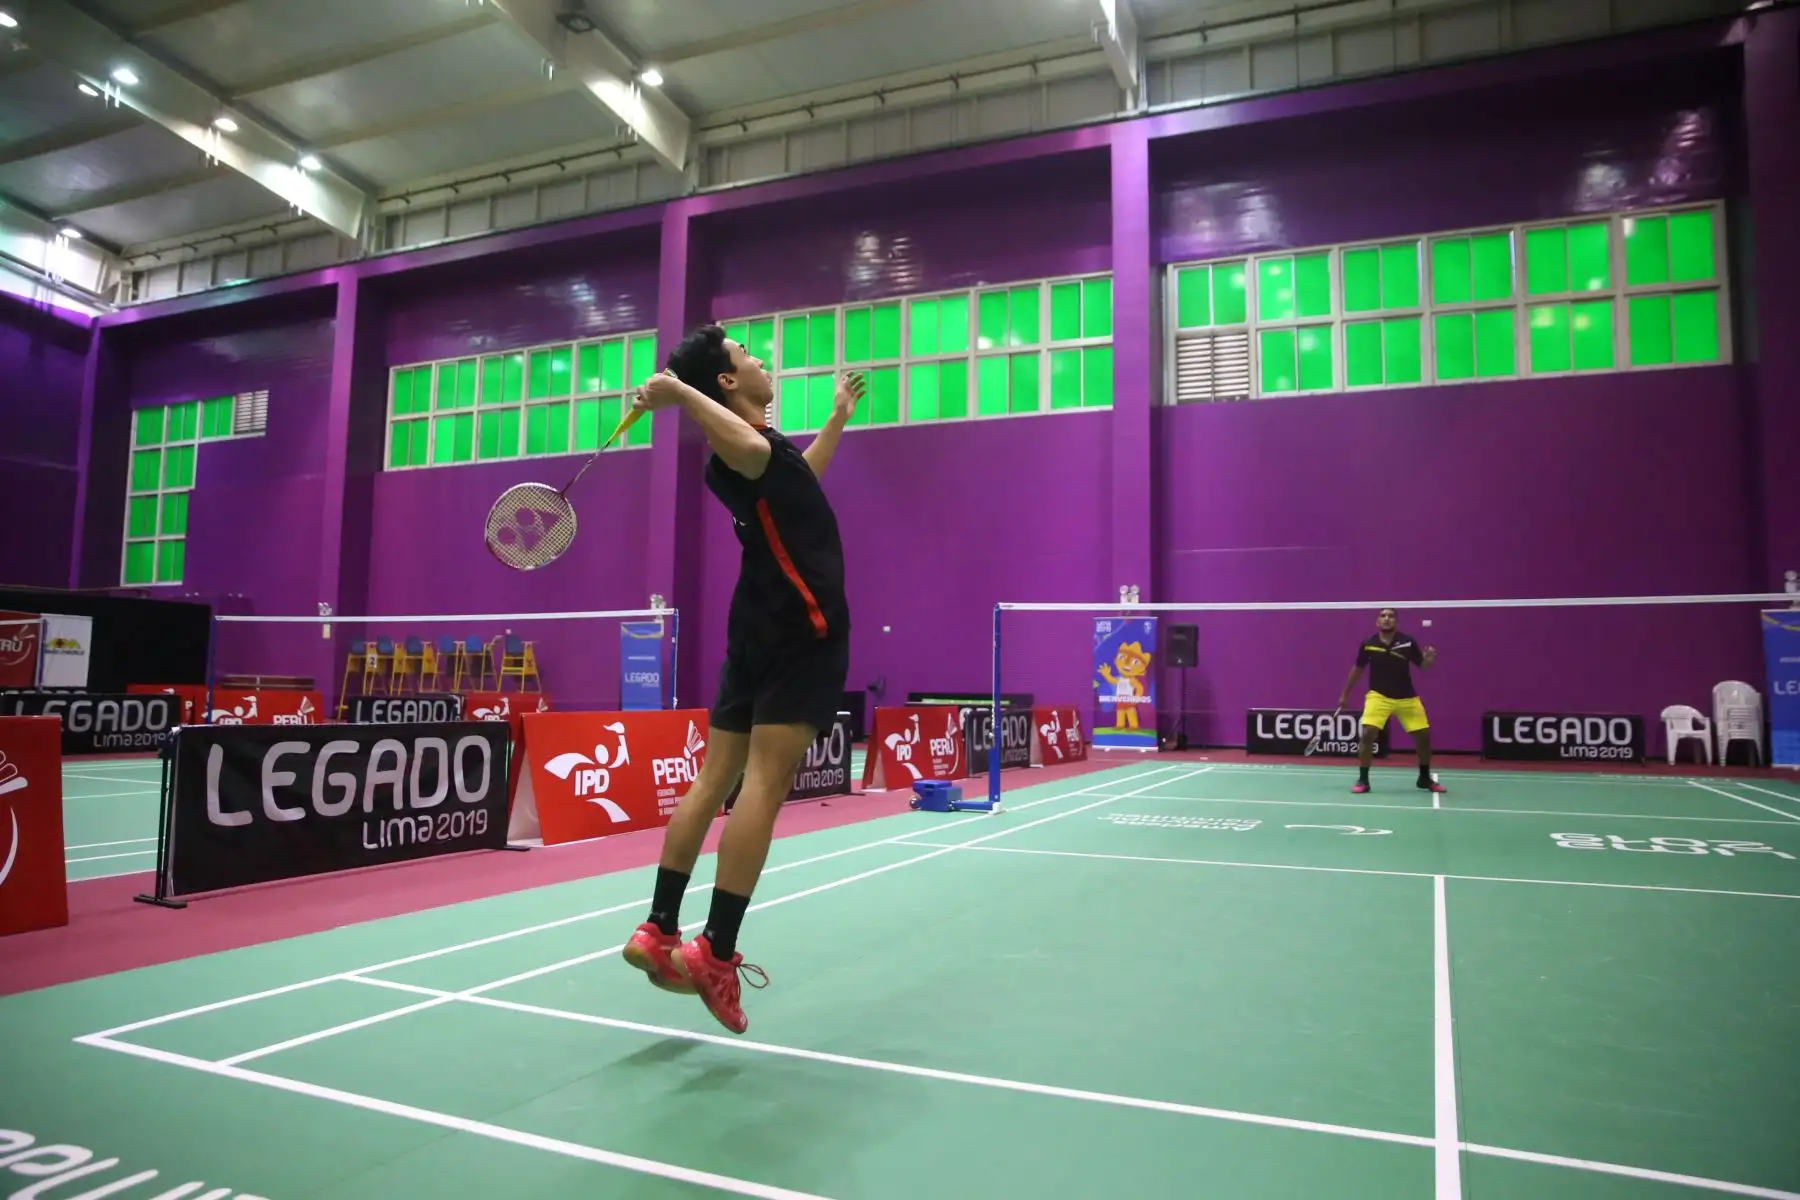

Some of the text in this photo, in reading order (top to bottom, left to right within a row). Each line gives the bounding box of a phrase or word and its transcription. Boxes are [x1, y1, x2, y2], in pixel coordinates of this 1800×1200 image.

[356, 700, 447, 724] LEGADO
[973, 716, 1028, 751] LEADO
[1493, 716, 1632, 745] LEGADO
[896, 744, 912, 761] IPD
[1599, 747, 1633, 759] 2019
[206, 735, 492, 827] LEGADO
[574, 769, 610, 796] IPD
[821, 768, 845, 788] 2019
[437, 808, 488, 840] 2019
